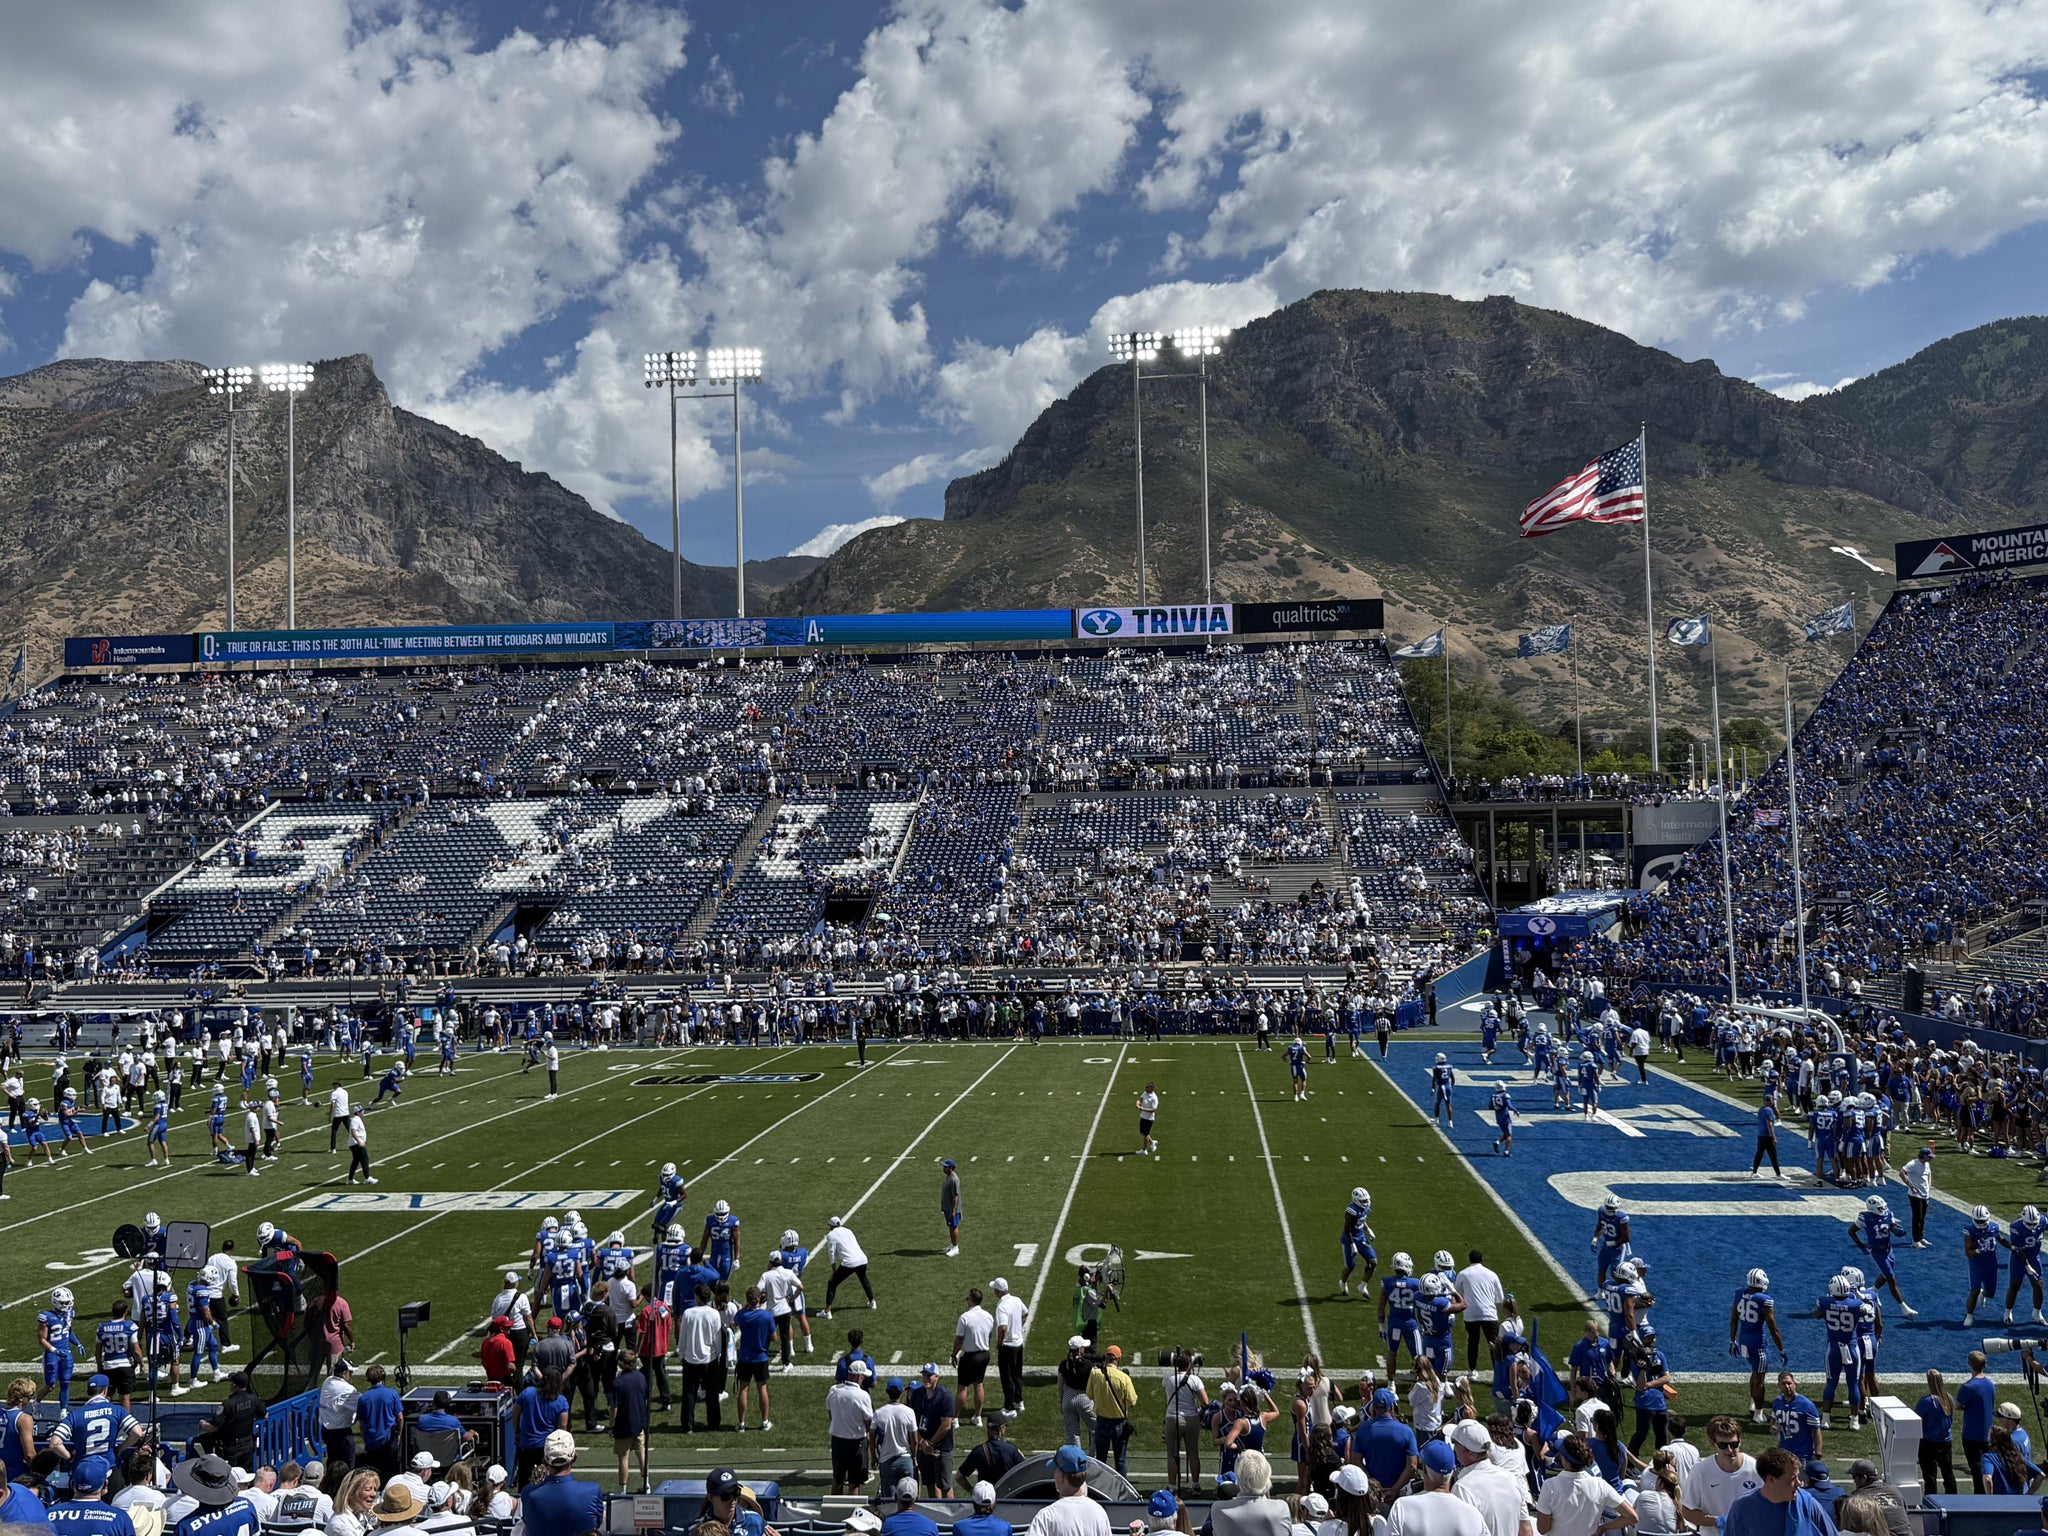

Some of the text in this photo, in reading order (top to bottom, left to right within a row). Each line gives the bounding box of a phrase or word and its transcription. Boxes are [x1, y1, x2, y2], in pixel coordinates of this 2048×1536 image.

[1132, 606, 1229, 634] TRIVIA
[806, 619, 824, 642] A:
[114, 646, 166, 655] Intermountain
[203, 634, 220, 660] Q:
[226, 632, 607, 653] TRUE OR FALSE: THIS IS THE 30TH ALL-TIME MEETING BETWEEN THE COUGARS AND WILDCATS
[114, 655, 137, 663] Health
[1661, 831, 1697, 841] Health
[1441, 1068, 1449, 1079] 2
[1580, 1066, 1588, 1078] 4
[1816, 1115, 1834, 1130] 97
[711, 1226, 731, 1240] 54
[552, 1259, 577, 1279] 43
[661, 1254, 681, 1272] 16
[1388, 1288, 1414, 1309] 42
[1737, 1298, 1759, 1323] 46
[1825, 1310, 1855, 1332] 59
[50, 1321, 71, 1342] 24
[102, 1332, 131, 1354] 38
[84, 1407, 113, 1418] ROBERTS
[86, 1418, 111, 1456] 2
[48, 1510, 81, 1522] BYU
[190, 1510, 222, 1531] BYU
